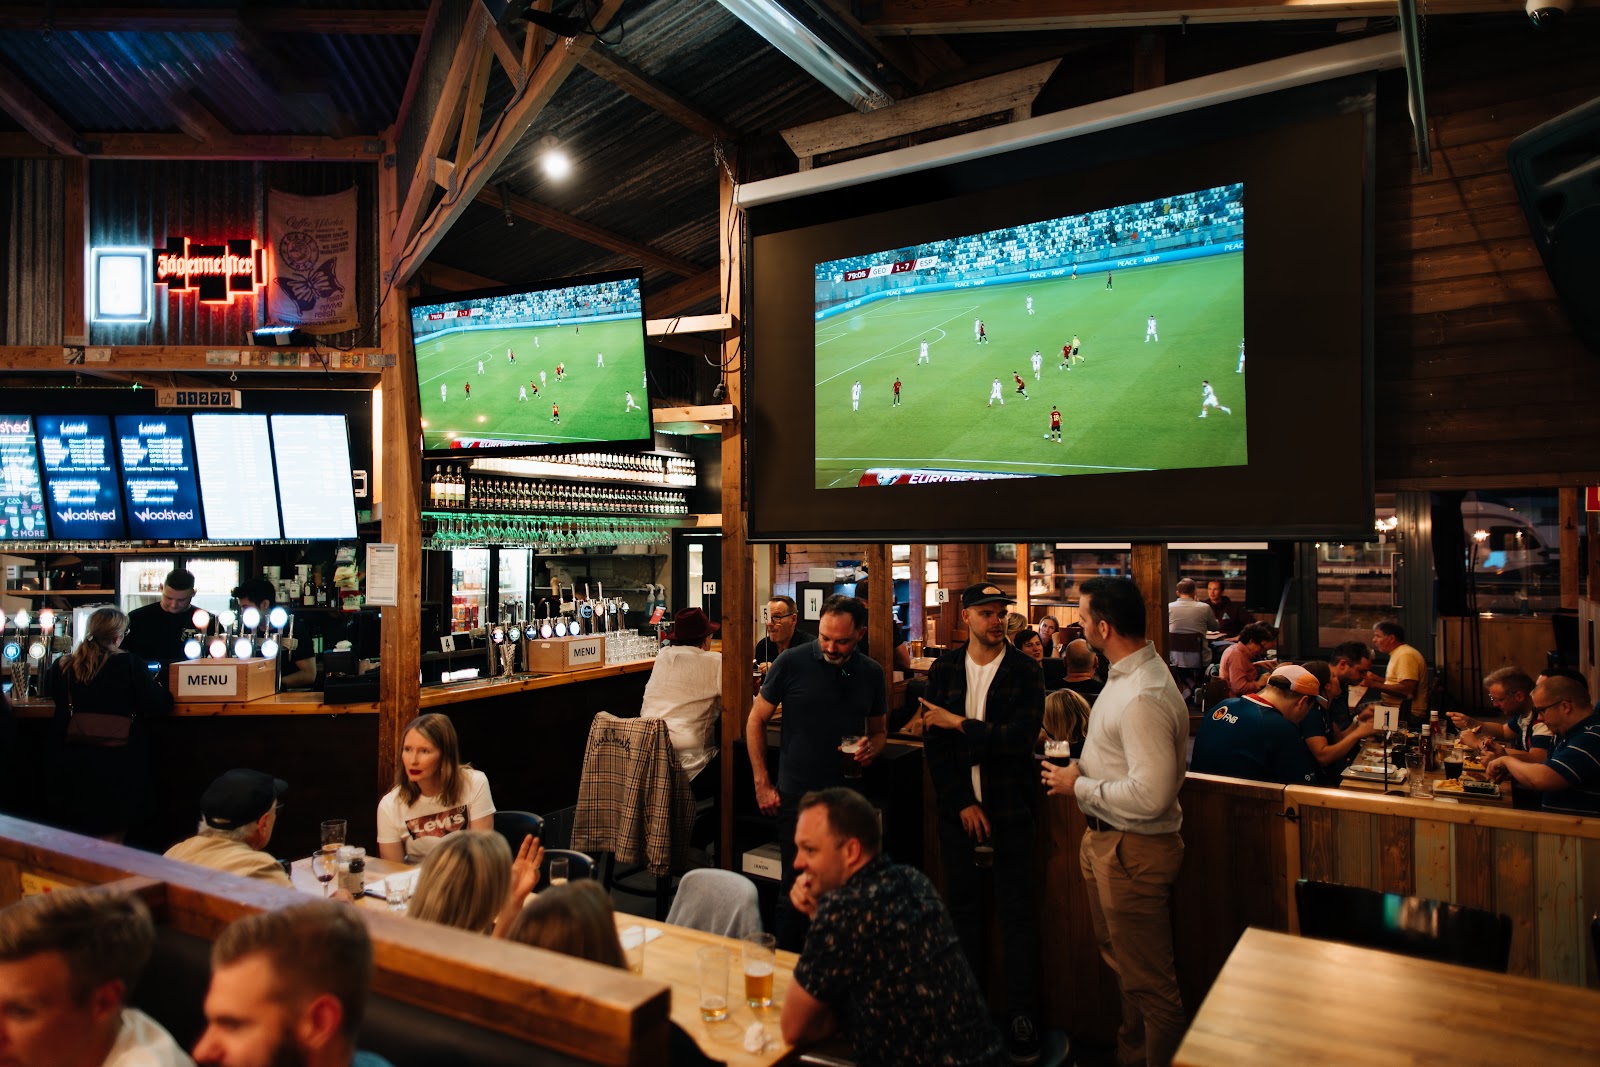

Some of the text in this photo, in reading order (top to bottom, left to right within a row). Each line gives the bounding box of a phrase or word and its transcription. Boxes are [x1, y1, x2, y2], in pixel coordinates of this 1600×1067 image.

[286, 216, 313, 230] Coffee
[1125, 219, 1154, 230] MORE
[157, 253, 253, 277] Jägermeister
[1118, 259, 1137, 267] PEACE
[848, 271, 866, 280] 79:05
[326, 294, 345, 302] relax
[320, 302, 342, 310] revive
[314, 309, 336, 318] relish
[60, 422, 87, 434] Lunch
[139, 422, 166, 434] Lunch
[57, 508, 116, 522] Woolshed
[135, 508, 193, 522] Woolshed
[939, 591, 944, 600] 8
[764, 608, 767, 619] 5
[445, 639, 450, 647] 4
[574, 646, 596, 657] MENU
[188, 675, 228, 685] MENU
[1222, 713, 1238, 724] FNB
[1385, 711, 1390, 726] 1
